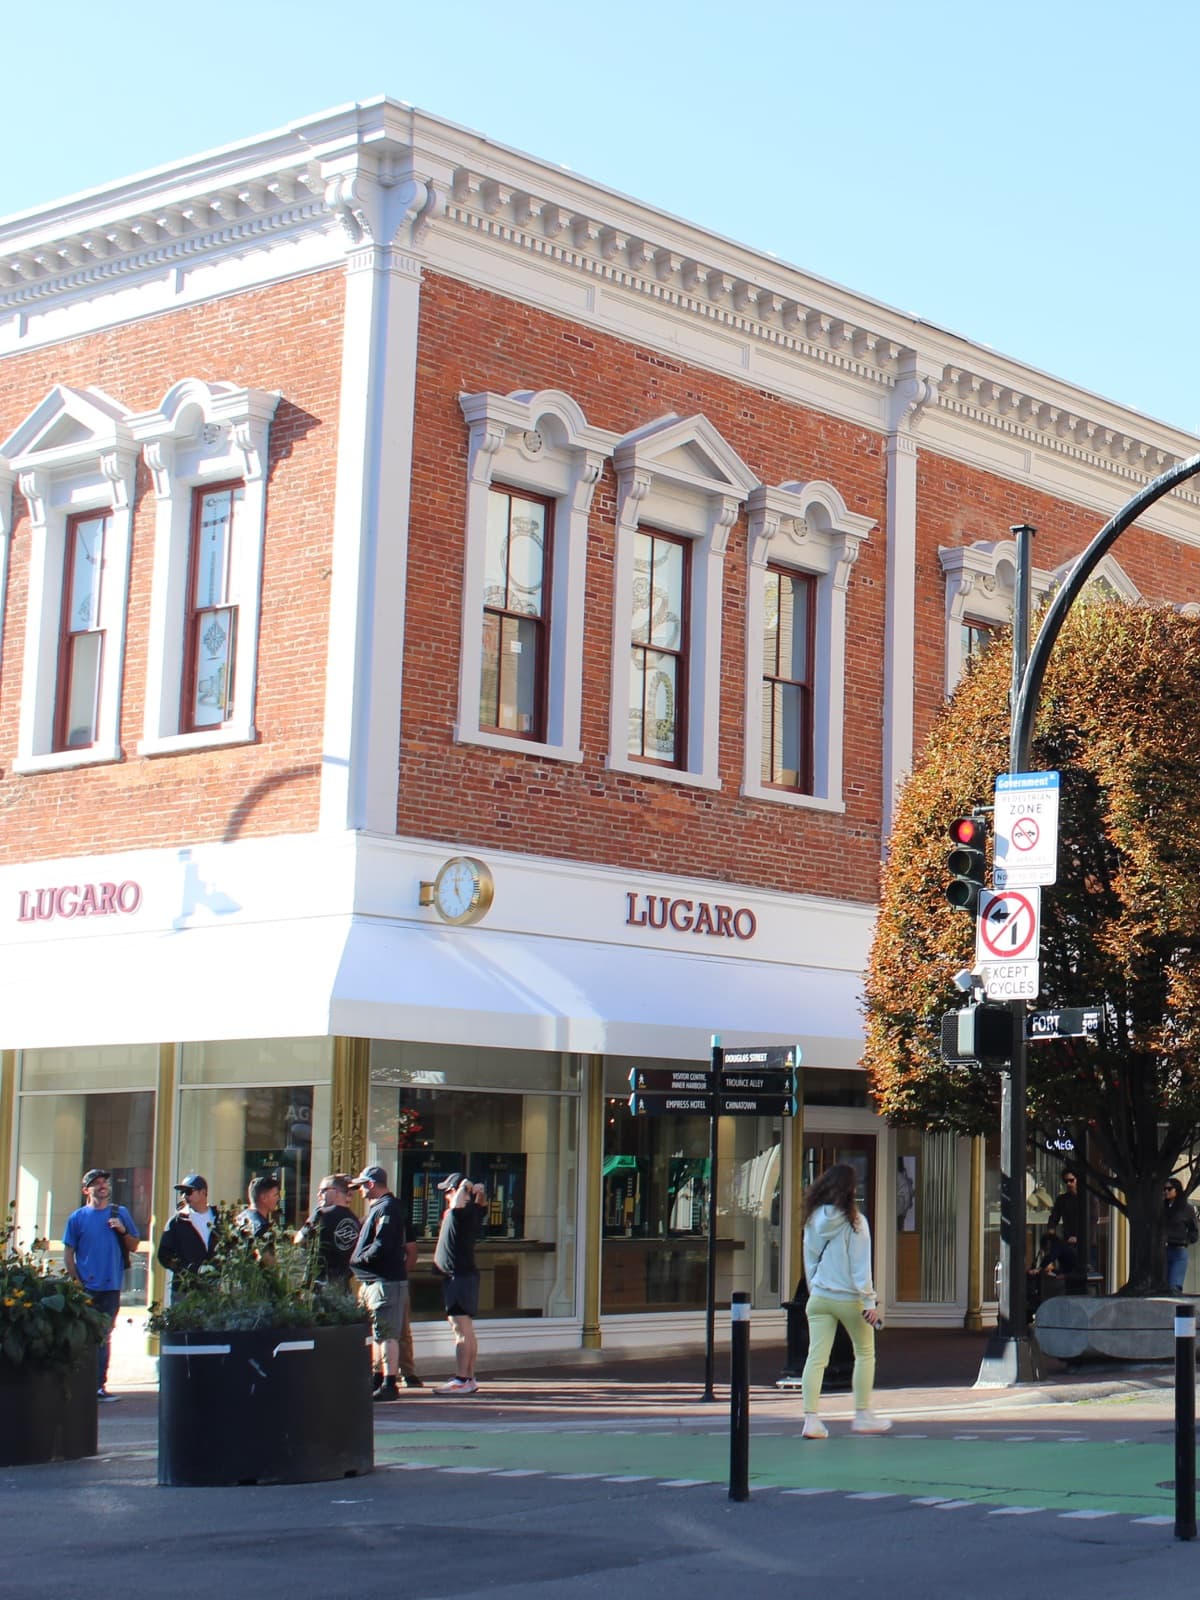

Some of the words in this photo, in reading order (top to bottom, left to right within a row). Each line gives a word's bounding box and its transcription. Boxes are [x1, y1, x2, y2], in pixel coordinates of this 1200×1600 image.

[998, 777, 1049, 789] Government
[1009, 803, 1044, 815] ZONE
[17, 880, 141, 922] LUGARO
[626, 892, 757, 940] LUGARO
[984, 966, 1029, 980] EXCEPT
[986, 981, 1034, 994] ICYCLES
[1032, 1015, 1060, 1032] FORT
[1081, 1019, 1098, 1030] 500
[725, 1053, 748, 1063] DOUGLAS
[749, 1052, 768, 1062] STREET
[672, 1073, 689, 1081] VISITOR
[690, 1073, 707, 1081] CENTRE
[726, 1078, 748, 1087] TROUNCE
[750, 1079, 764, 1087] ALLEY
[672, 1081, 685, 1089] INNER
[666, 1100, 689, 1109] EMPRESS
[690, 1100, 706, 1109] HOTEL
[725, 1102, 757, 1110] CHINATOWN
